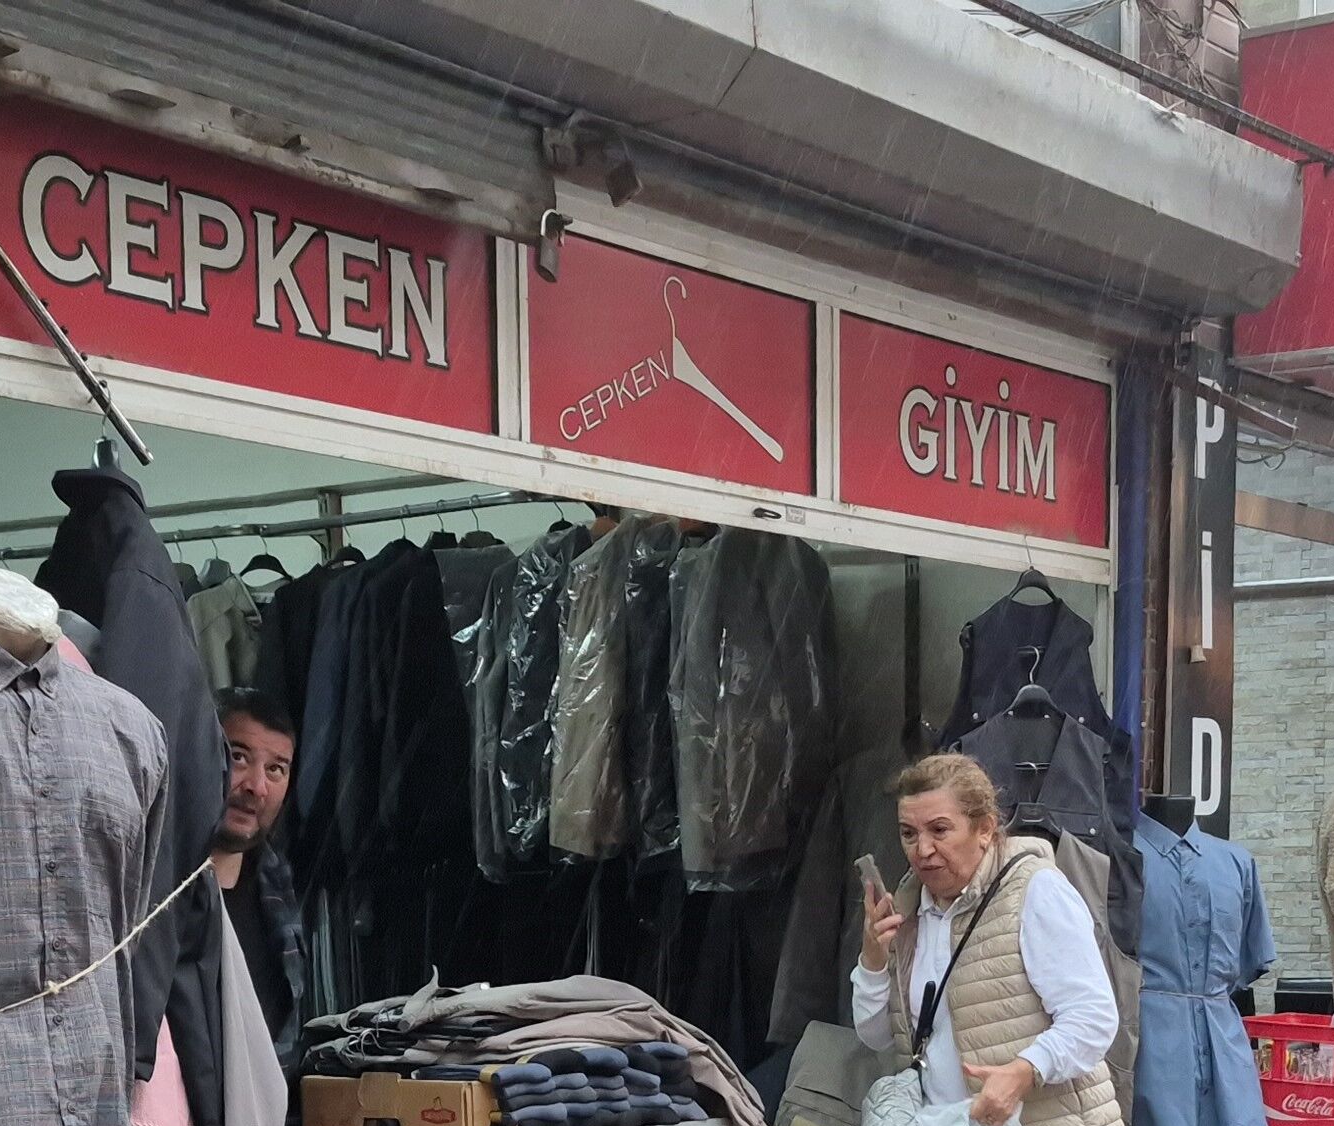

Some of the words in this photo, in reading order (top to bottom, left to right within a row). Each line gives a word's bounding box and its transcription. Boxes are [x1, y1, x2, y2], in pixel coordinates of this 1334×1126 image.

[20, 153, 449, 369] CEPKEN
[558, 351, 670, 442] CEPKEN
[898, 365, 1057, 503] GİYİM
